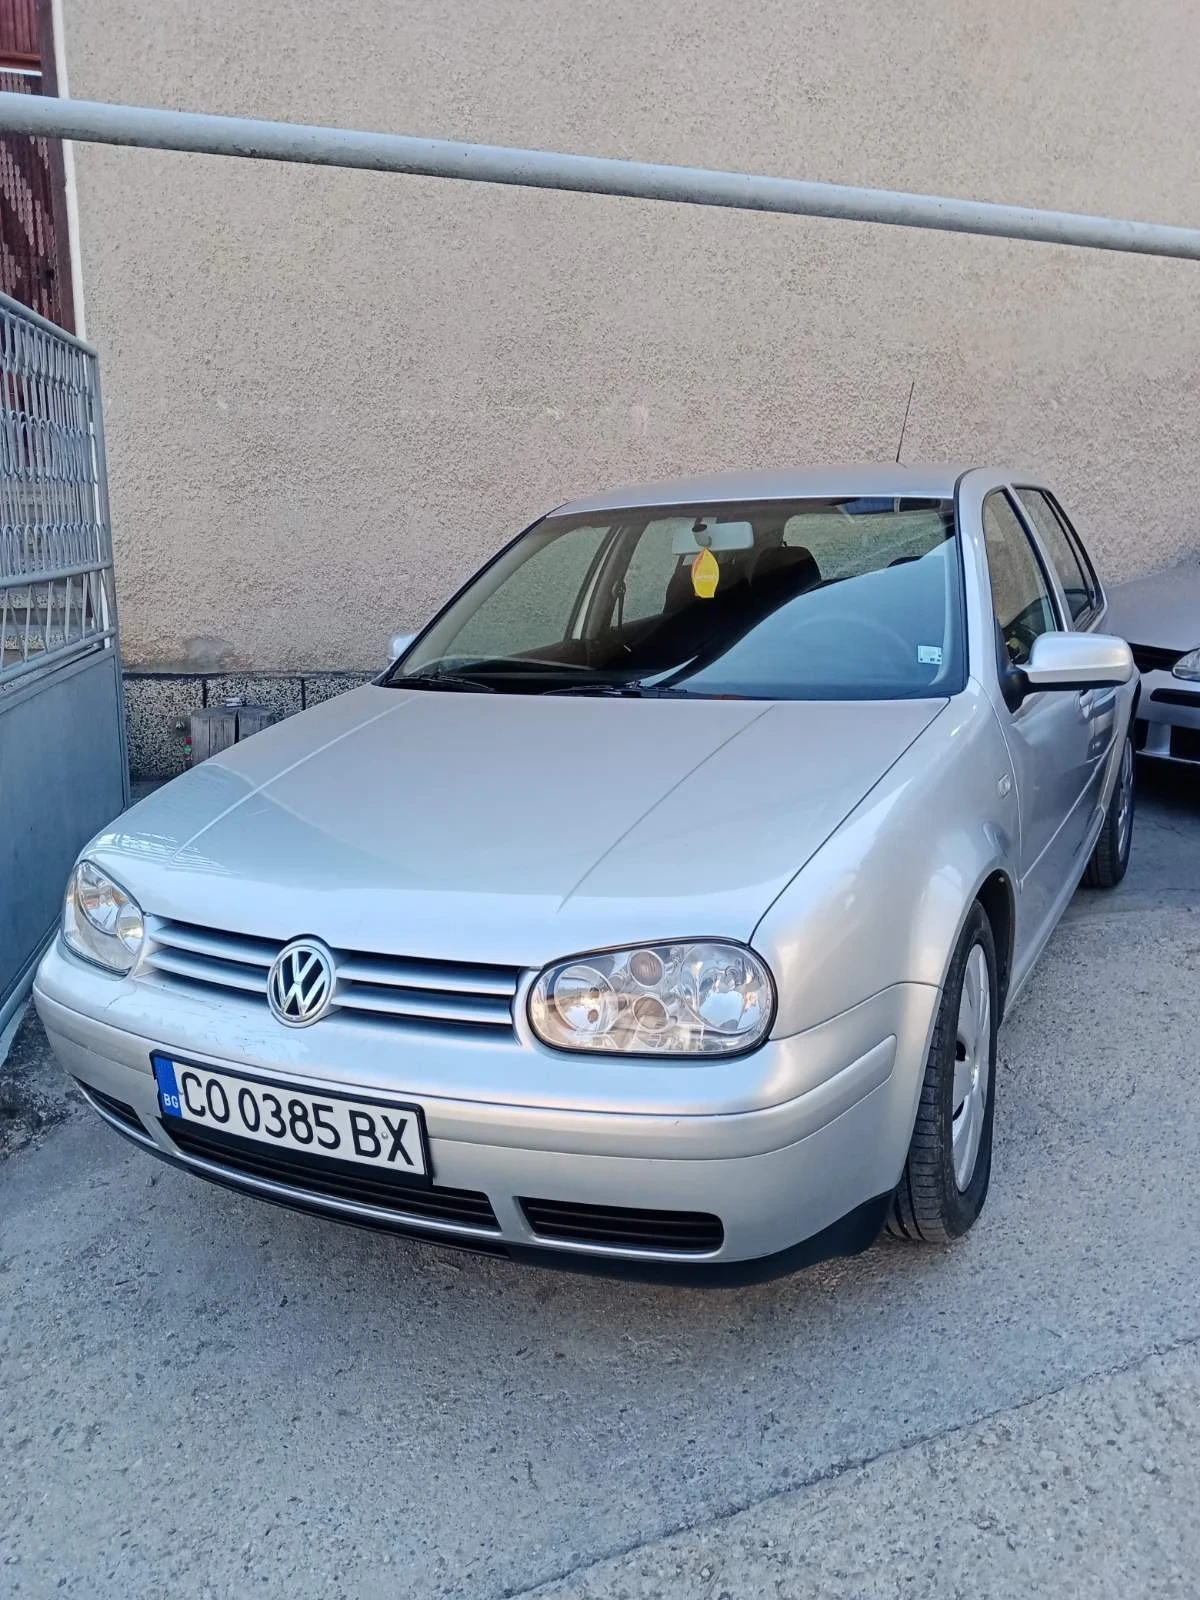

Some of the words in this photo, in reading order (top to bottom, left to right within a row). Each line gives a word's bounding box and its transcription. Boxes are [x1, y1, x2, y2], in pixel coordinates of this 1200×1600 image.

[272, 946, 330, 1019] VW
[163, 1092, 180, 1109] BG
[181, 1071, 230, 1124] CO
[238, 1087, 341, 1150] 0385
[348, 1109, 415, 1166] BX
